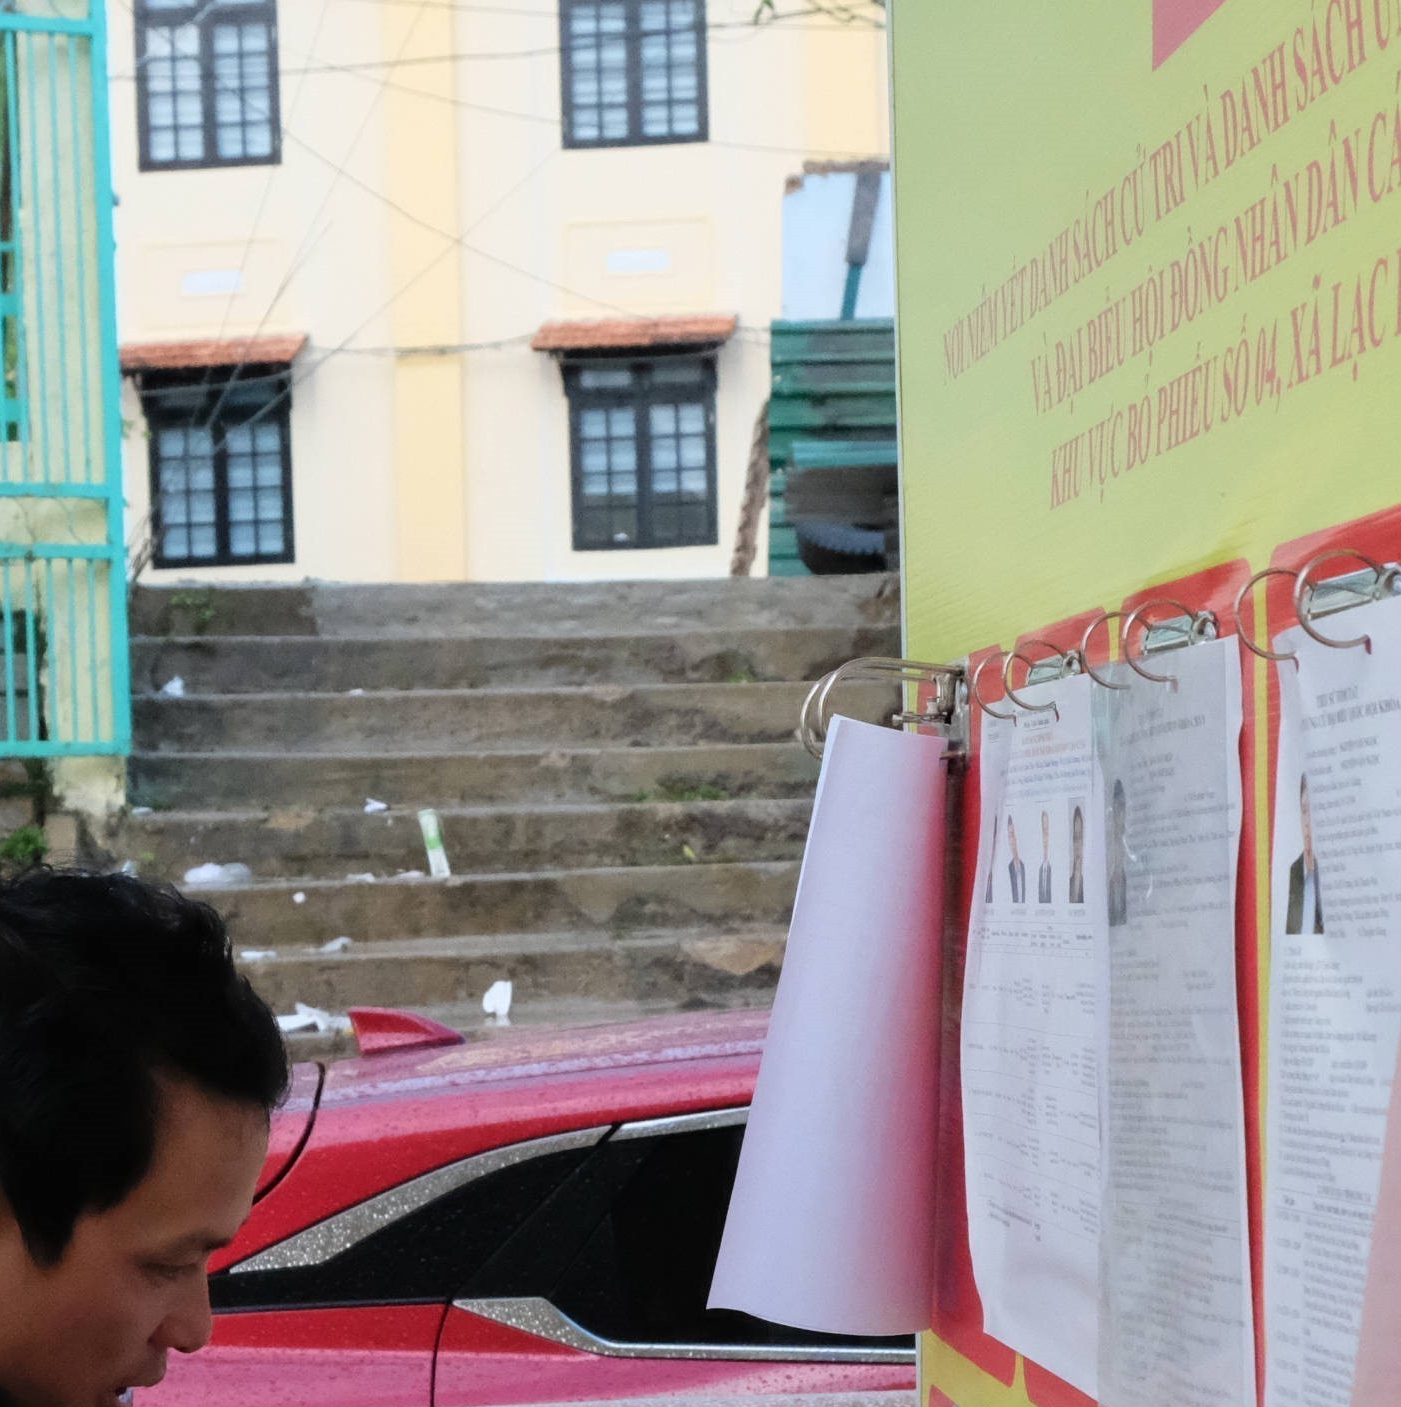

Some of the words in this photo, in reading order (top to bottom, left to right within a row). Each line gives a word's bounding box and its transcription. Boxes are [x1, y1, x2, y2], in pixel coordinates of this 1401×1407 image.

[1029, 226, 1070, 320] DANH
[1073, 189, 1118, 284] SÁCH
[1121, 143, 1146, 246] CỬ
[1150, 130, 1186, 222] TRI
[1186, 83, 1220, 193] VÀ
[1220, 41, 1290, 170] DANH
[1031, 331, 1053, 416] VÀ
[1055, 327, 1083, 415] ĐẠI
[1131, 265, 1166, 366] HỘI
[1169, 224, 1230, 333] ĐỒNG
[1234, 163, 1299, 292] NHÂN
[1305, 118, 1361, 246] DÂN
[1049, 431, 1085, 511] KHU
[1155, 341, 1219, 457] PHIẾU
[1221, 312, 1251, 424] SỐ
[1255, 318, 1282, 413] 04,
[1287, 273, 1322, 390] XÃ
[1329, 256, 1389, 383] LẠC
